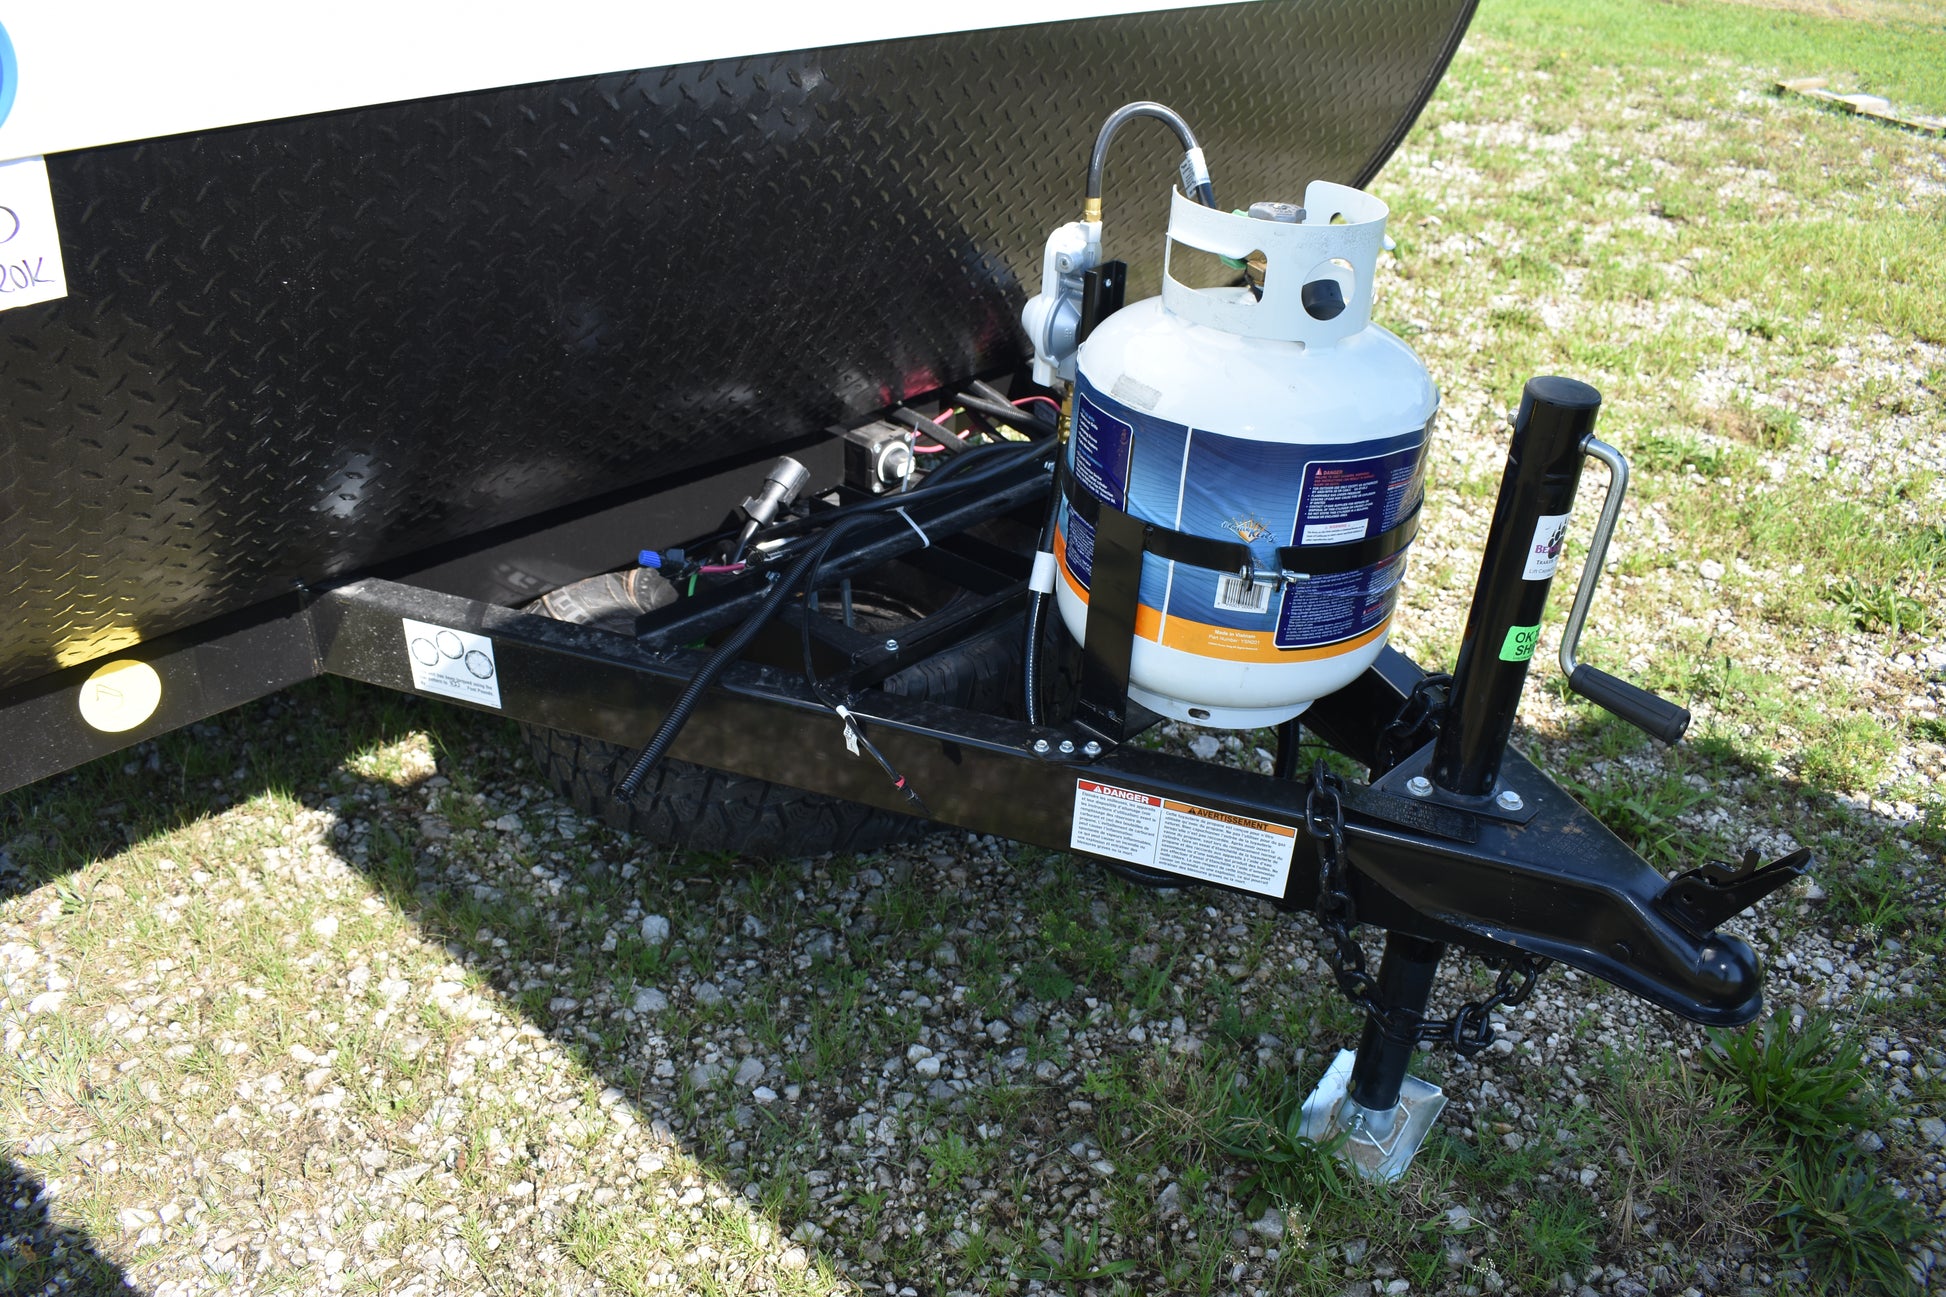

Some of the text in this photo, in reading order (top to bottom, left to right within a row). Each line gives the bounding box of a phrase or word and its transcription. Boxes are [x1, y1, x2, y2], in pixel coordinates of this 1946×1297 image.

[1516, 632, 1534, 643] OK
[1103, 786, 1150, 804] DANGER
[1196, 809, 1269, 830] AVERTISSEMENT
